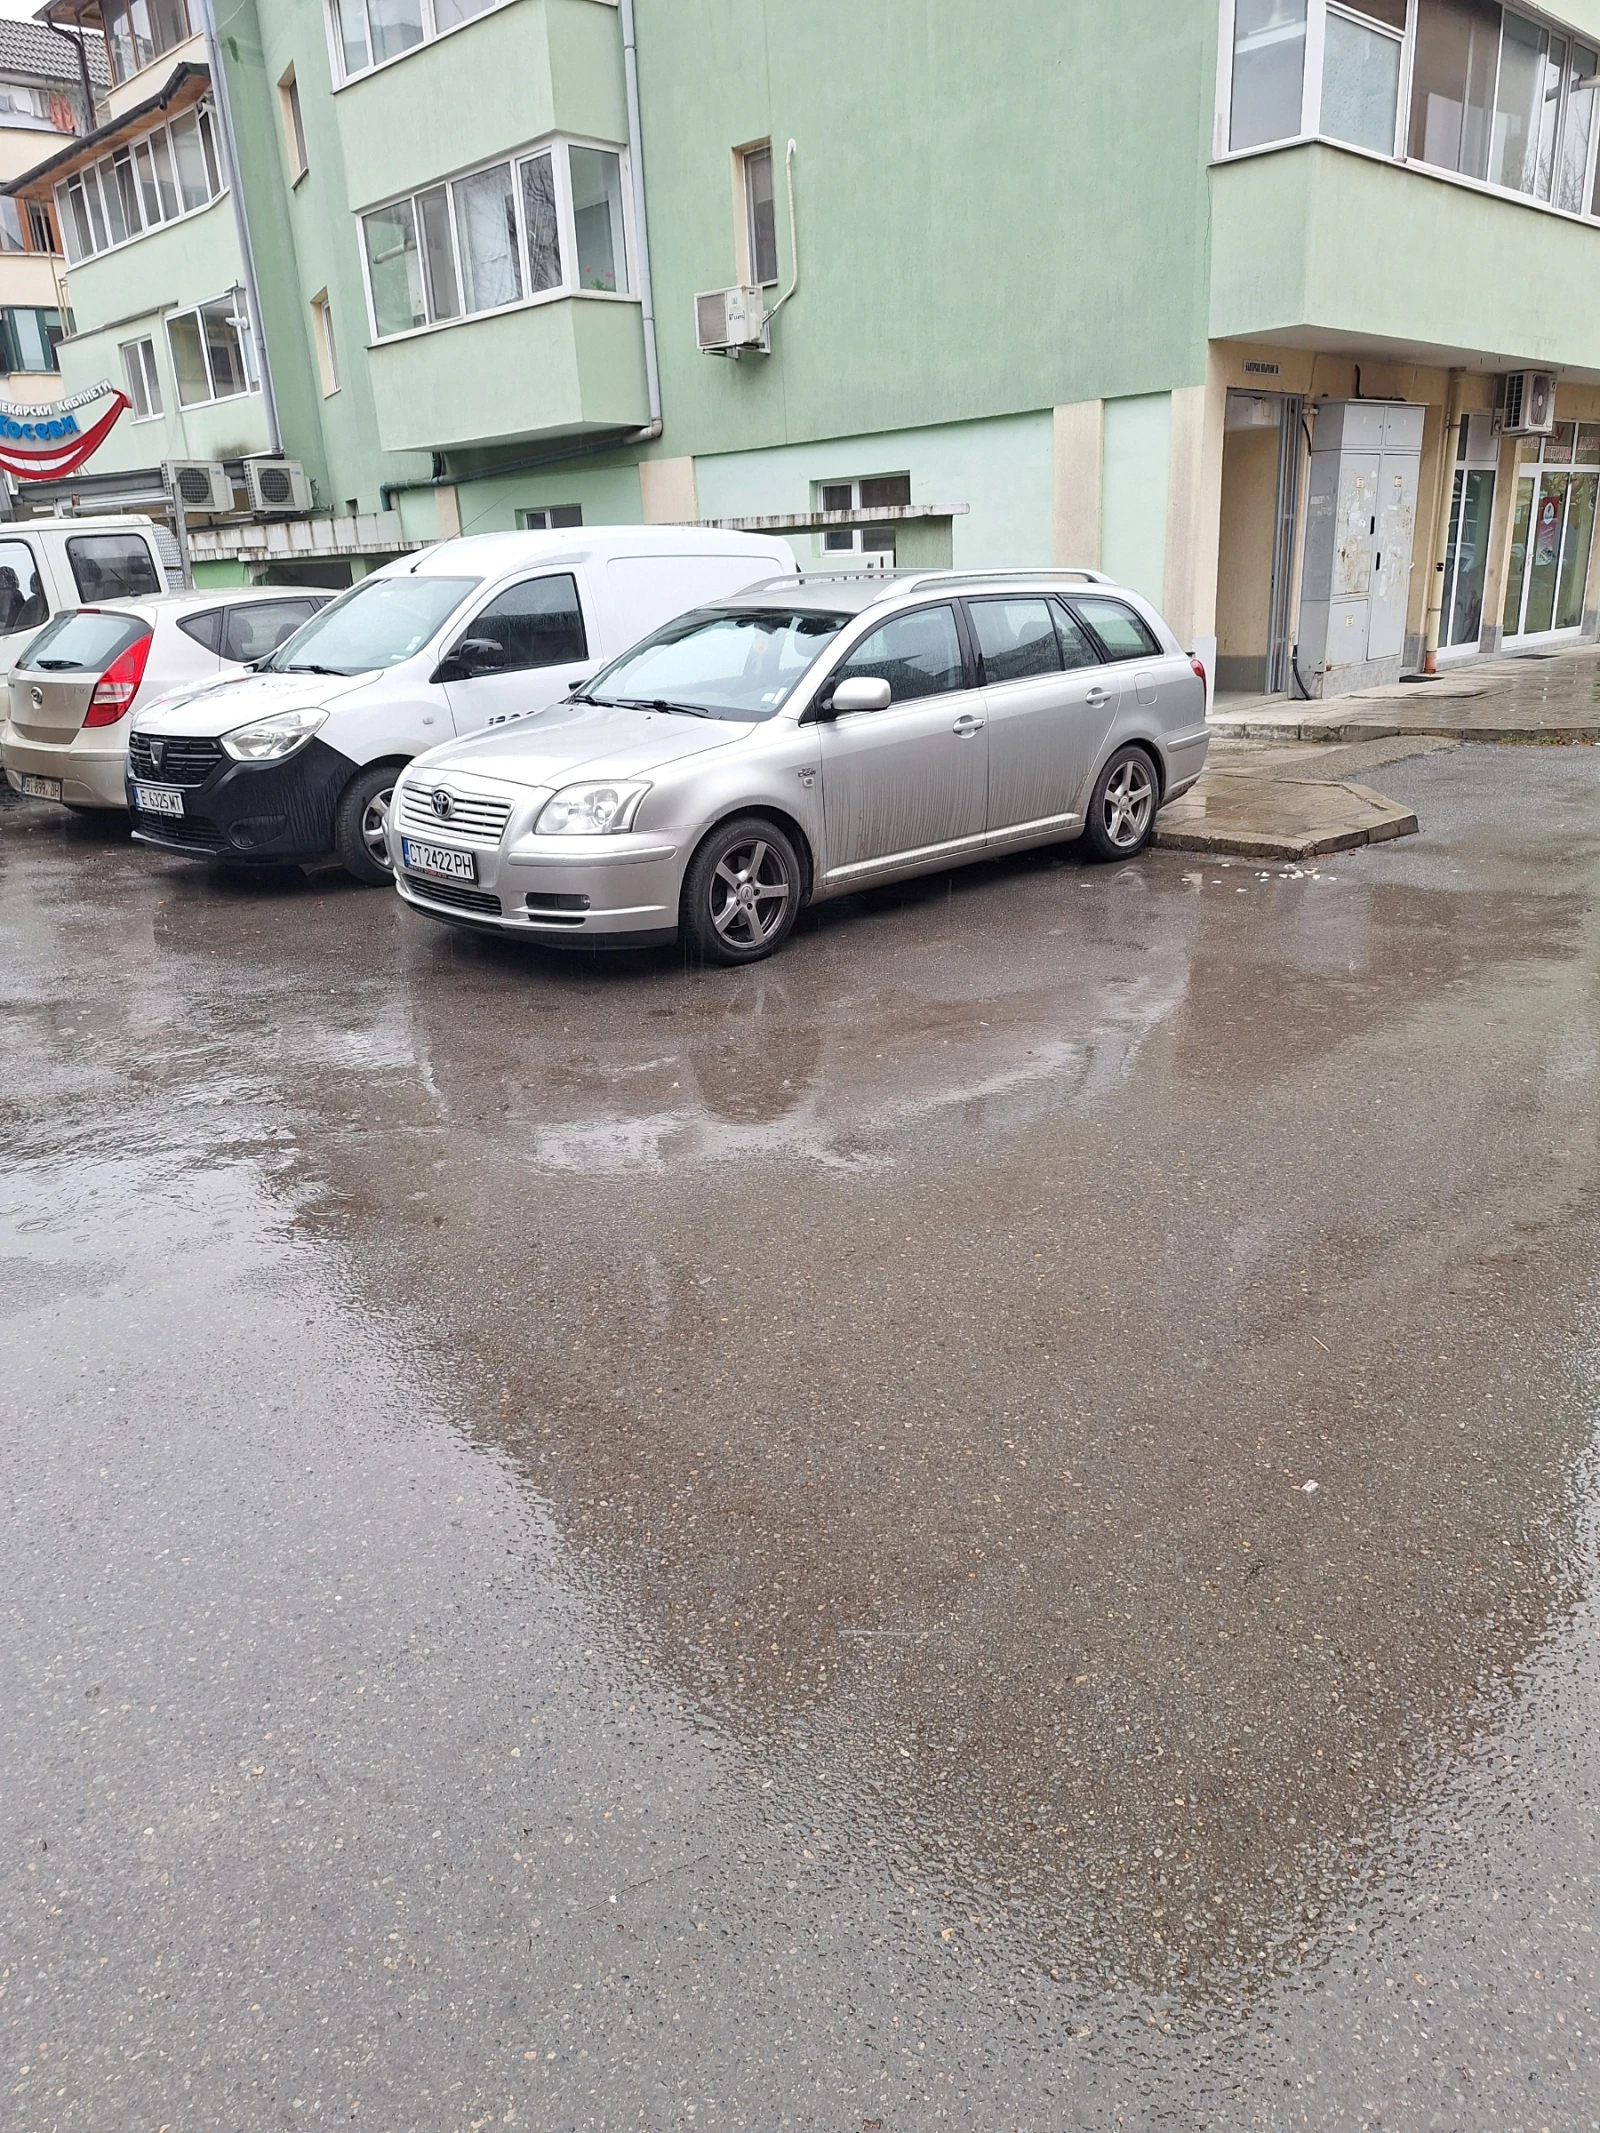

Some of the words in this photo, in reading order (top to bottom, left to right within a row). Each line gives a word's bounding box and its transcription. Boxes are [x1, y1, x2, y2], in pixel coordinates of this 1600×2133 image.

[0, 401, 53, 417] ЕКАРСКИ
[56, 379, 112, 412] КАБИНЕТИ
[409, 843, 422, 865] CT
[424, 847, 454, 873] 2422
[454, 853, 473, 877] PH
